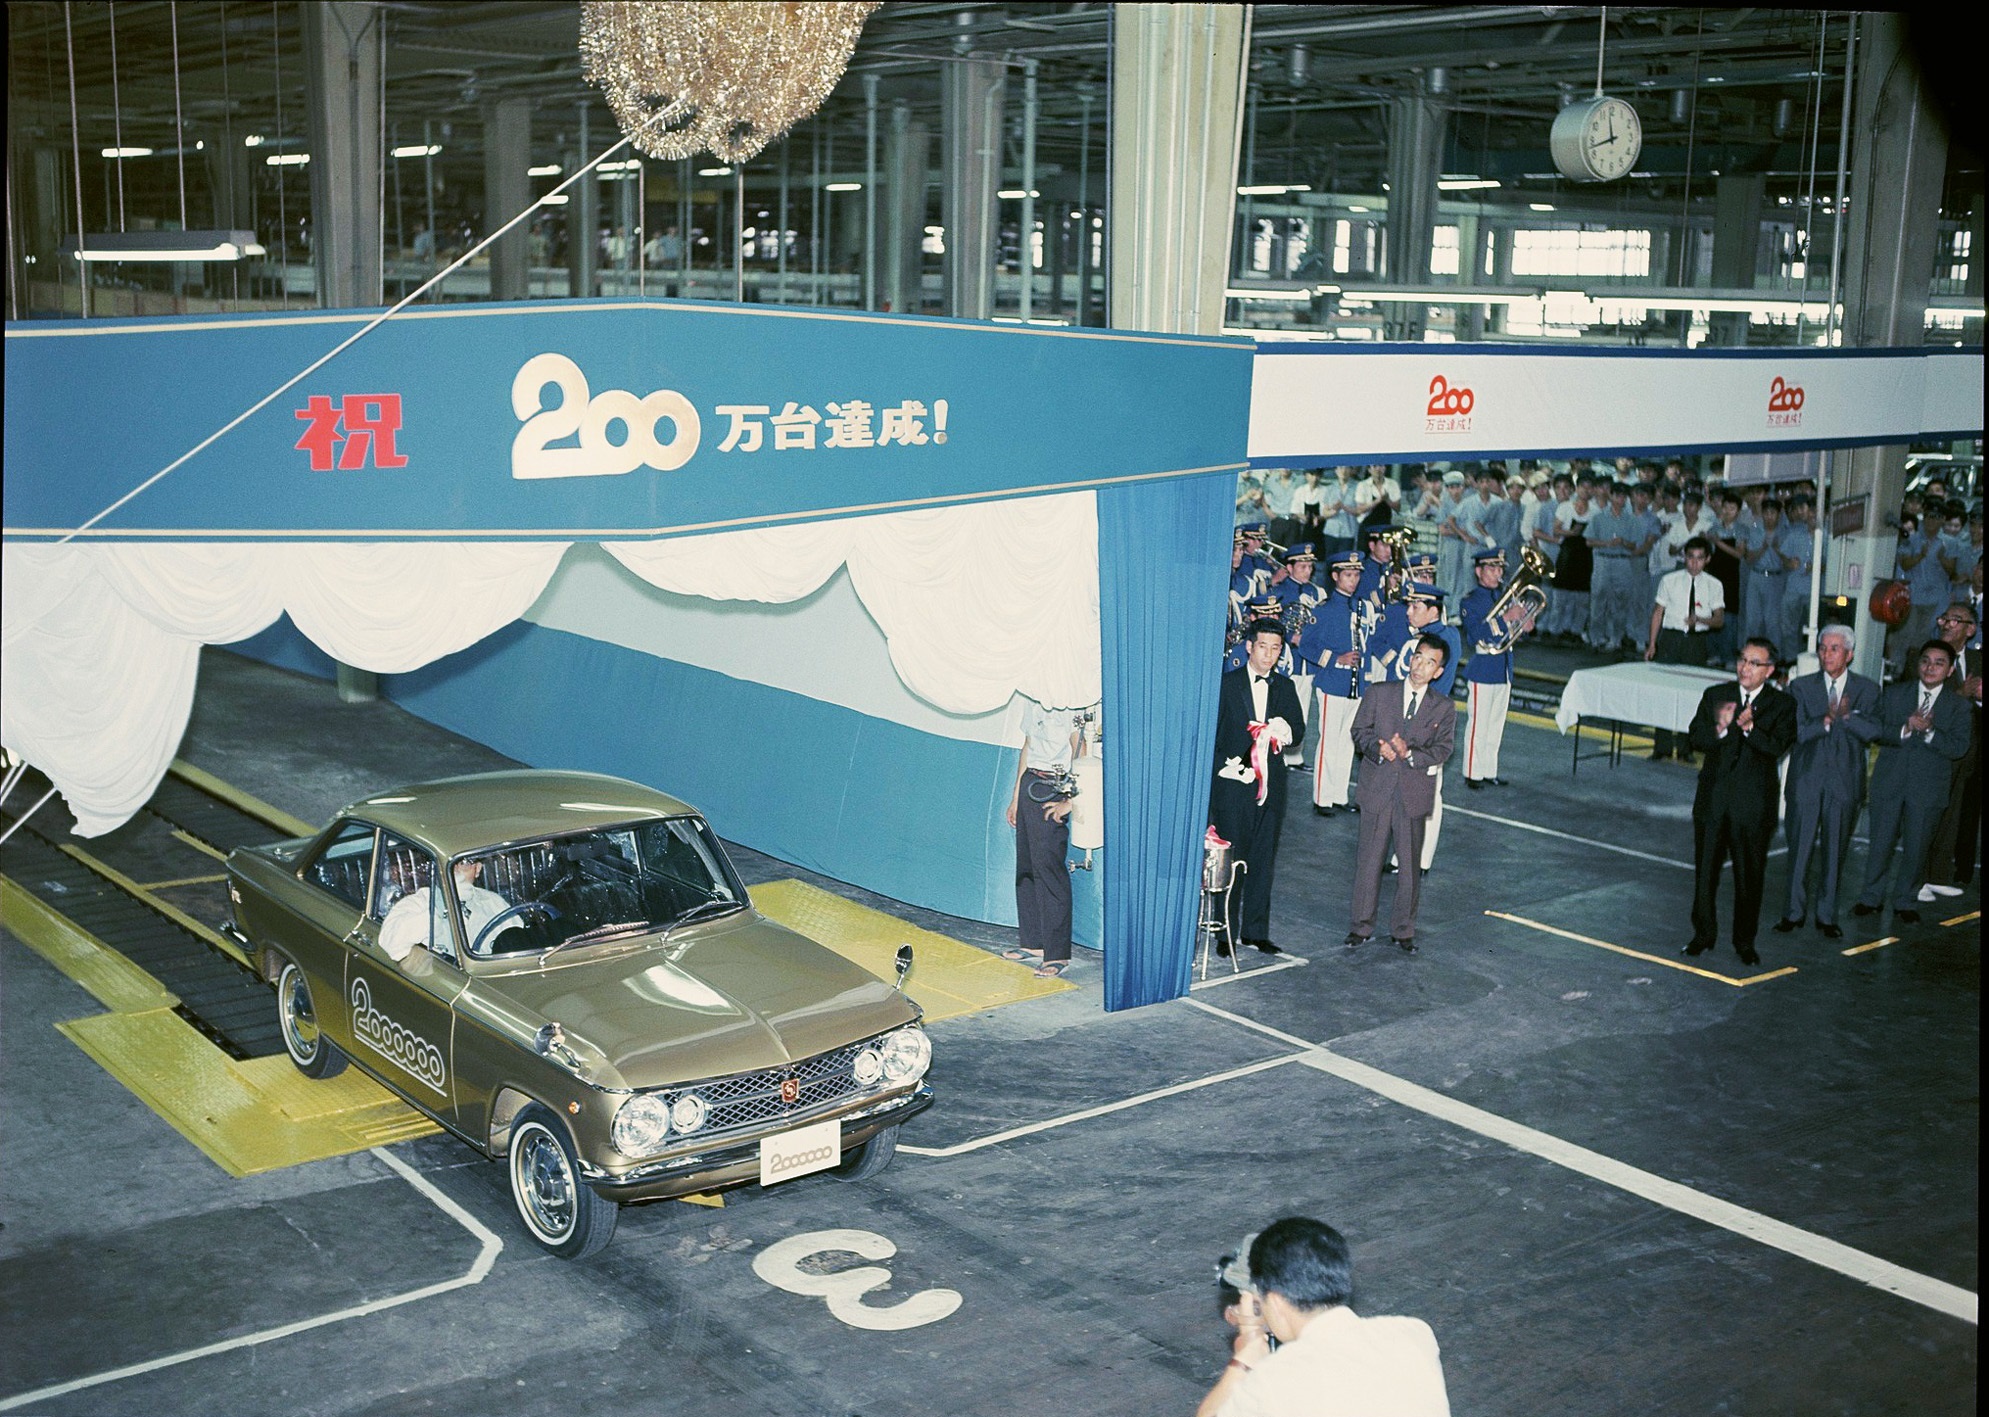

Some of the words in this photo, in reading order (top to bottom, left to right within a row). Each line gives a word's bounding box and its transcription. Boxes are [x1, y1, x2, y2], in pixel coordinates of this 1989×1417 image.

[1427, 374, 1475, 416] 200
[1768, 376, 1805, 412] 200
[294, 393, 409, 471] 祝
[511, 352, 701, 480] 200
[715, 399, 949, 453] 万台達成!
[351, 976, 446, 1088] 2000000
[770, 1145, 833, 1175] 2000000
